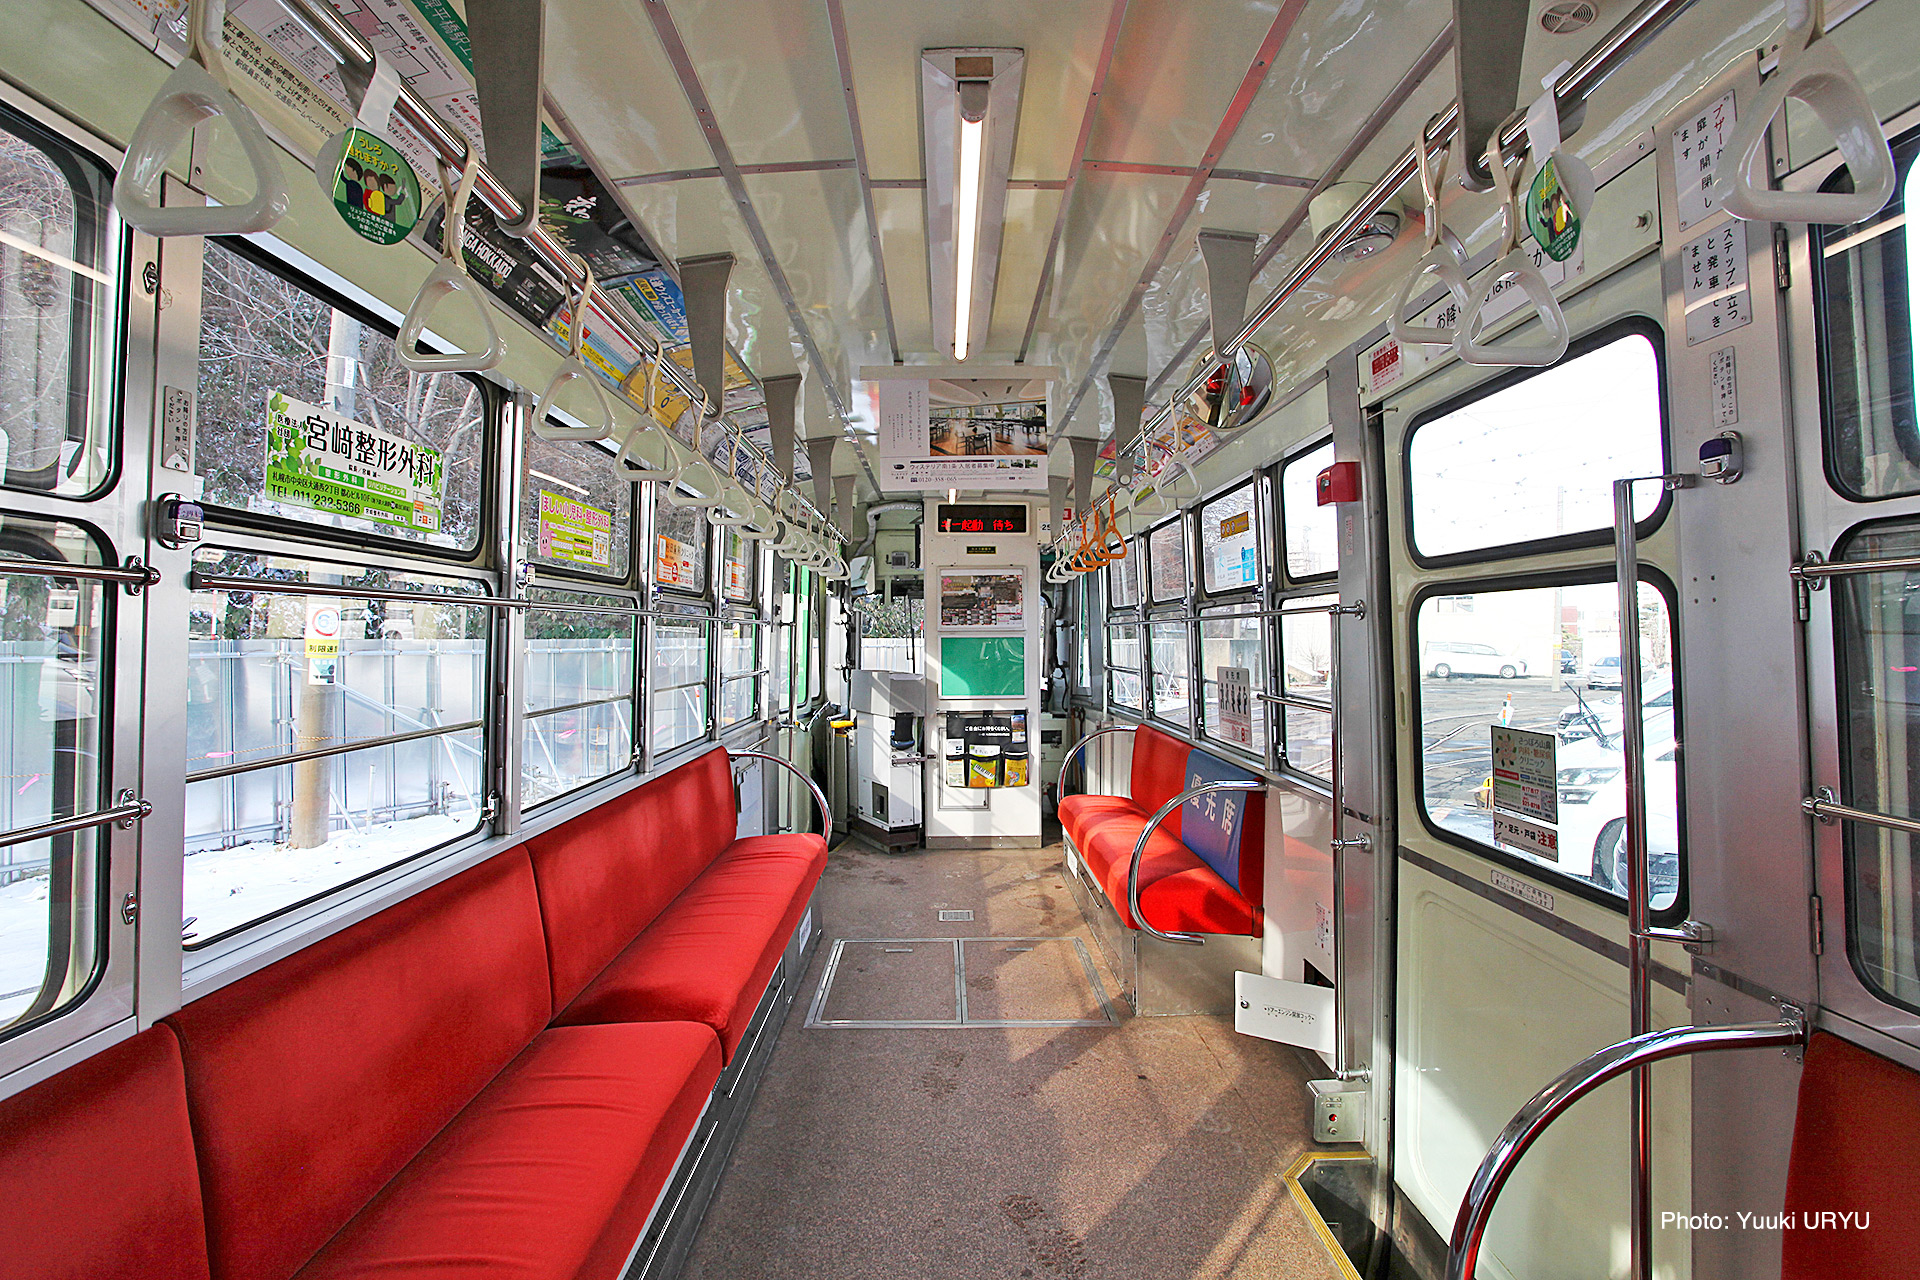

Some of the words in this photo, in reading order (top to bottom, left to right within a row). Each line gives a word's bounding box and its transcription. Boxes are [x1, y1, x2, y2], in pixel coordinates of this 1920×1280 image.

[358, 136, 383, 157] うしろ
[1681, 129, 1692, 160] ます
[1696, 116, 1713, 209] 扉が開閉し
[473, 241, 514, 279] HOKKAIDO
[1691, 245, 1703, 290] ません
[1724, 228, 1739, 320] ステップに立つ
[324, 468, 358, 485] 整形外科
[940, 519, 984, 532] キー起動
[992, 519, 1014, 532] 待ち
[1519, 756, 1546, 768] クリニック
[1537, 829, 1557, 850] 注意
